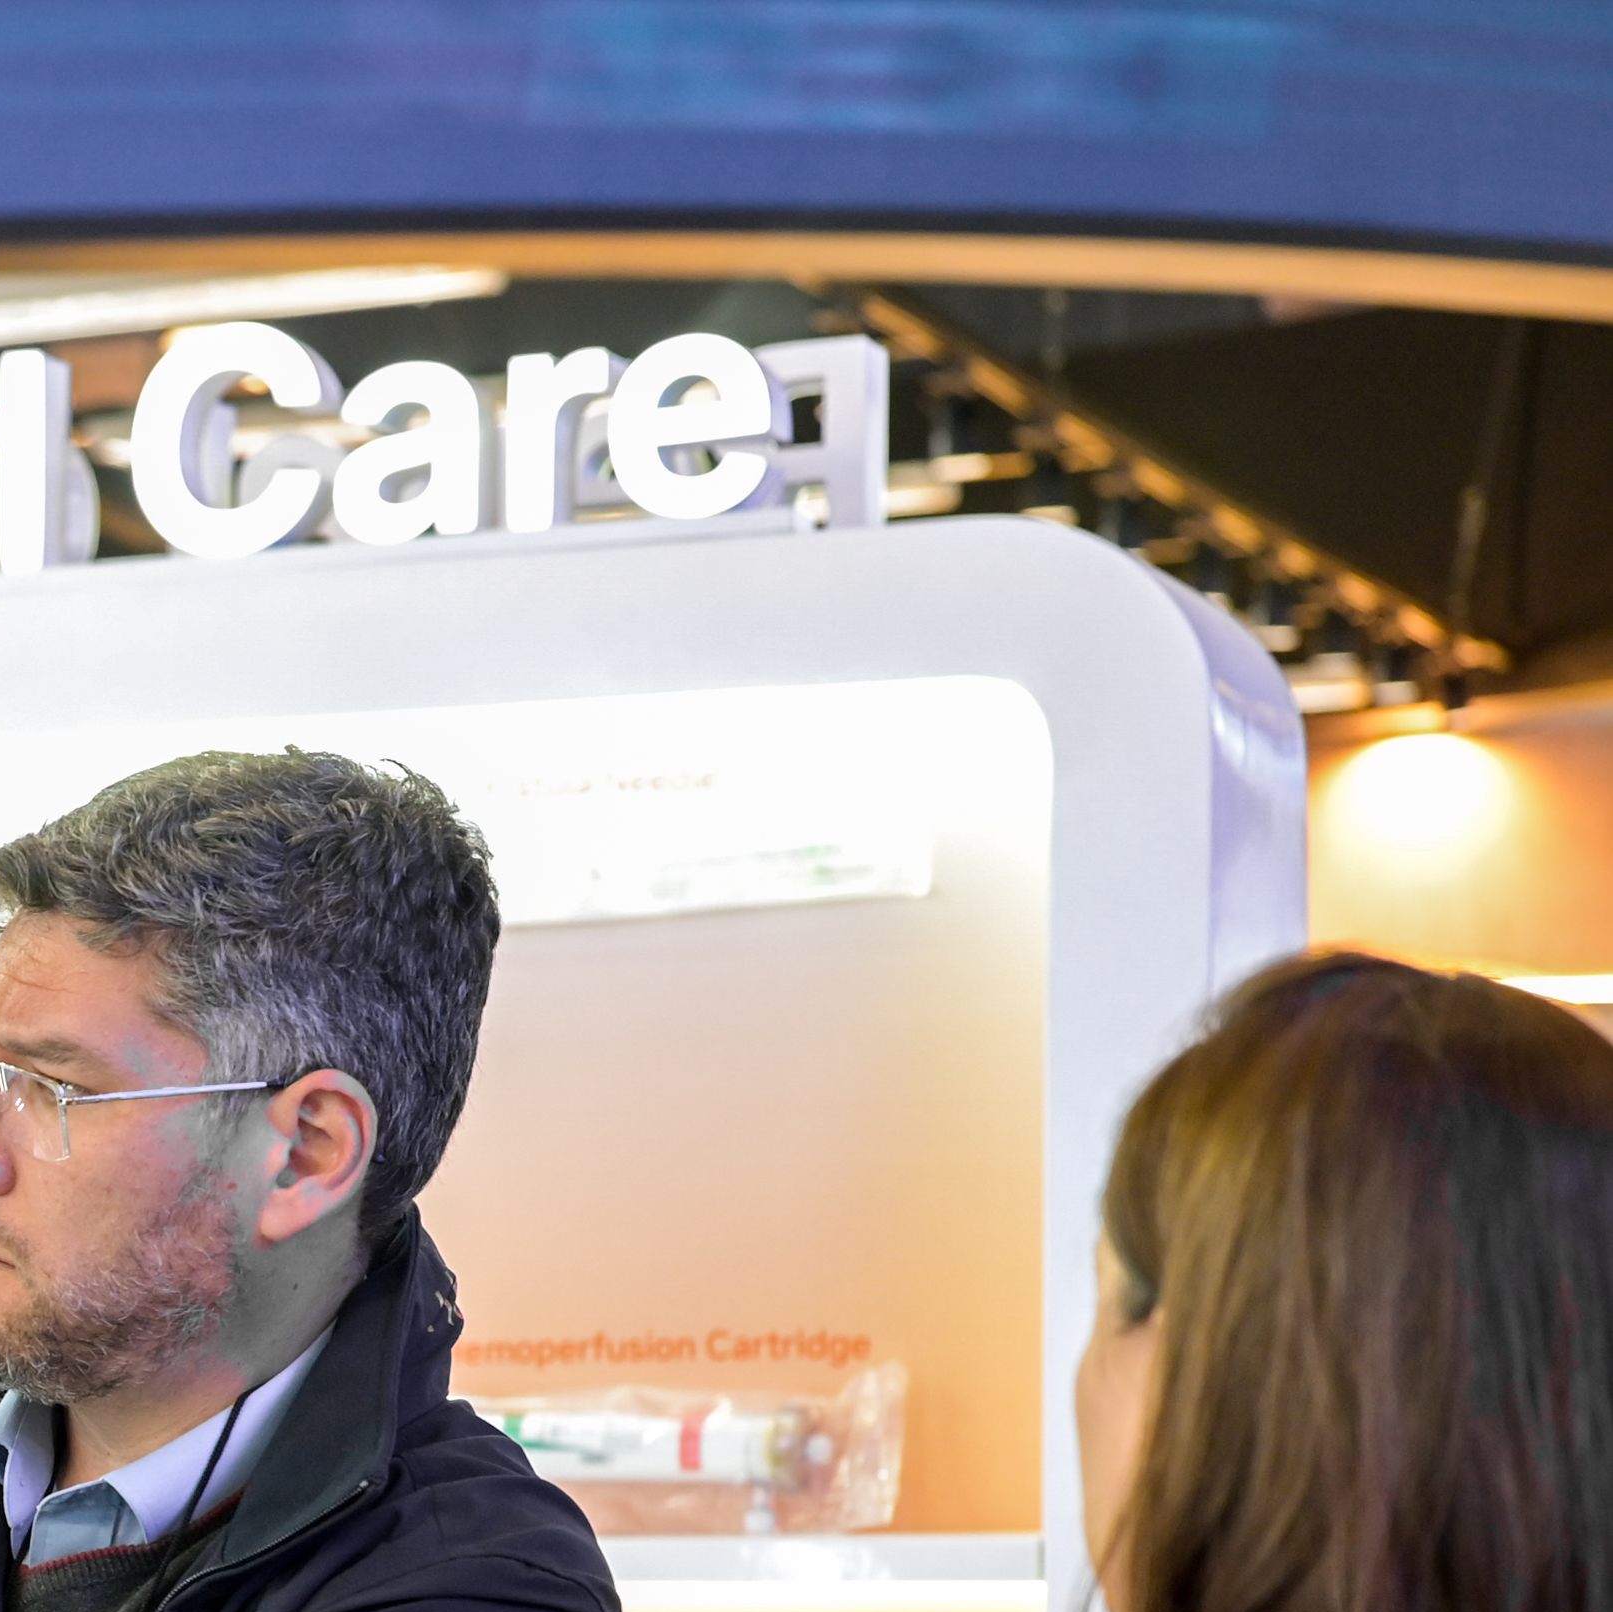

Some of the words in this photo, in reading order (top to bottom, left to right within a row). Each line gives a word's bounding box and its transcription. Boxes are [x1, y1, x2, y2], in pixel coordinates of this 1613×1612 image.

[129, 320, 771, 560] Care
[451, 1330, 697, 1367] emoperfusion
[706, 1328, 872, 1366] Cartridge
